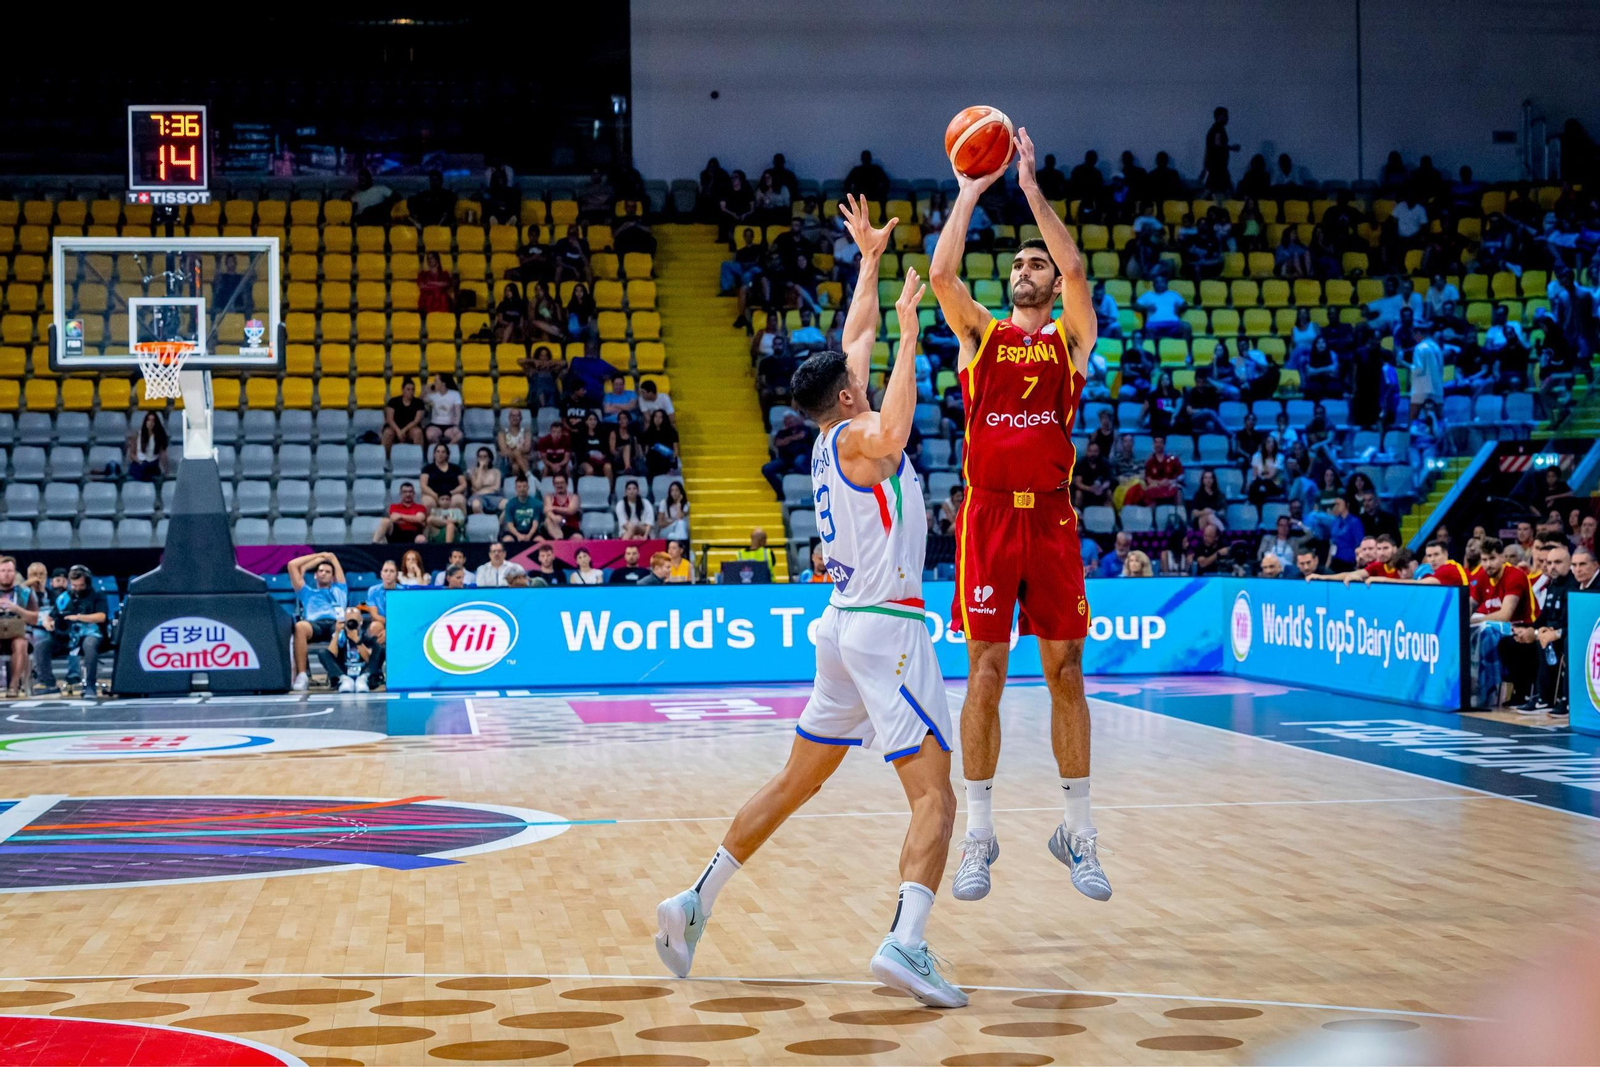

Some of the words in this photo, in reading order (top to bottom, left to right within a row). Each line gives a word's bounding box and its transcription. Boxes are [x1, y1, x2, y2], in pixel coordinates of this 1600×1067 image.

[150, 114, 200, 137] 7:36
[159, 144, 196, 181] 14
[150, 191, 210, 204] TISSOT
[996, 341, 1059, 364] ESPAÑA
[1021, 376, 1039, 399] 7
[160, 626, 225, 644] 百岁山
[446, 624, 497, 652] Yili
[560, 607, 756, 652] World's
[1089, 615, 1167, 649] oup
[1262, 603, 1313, 650] World's
[1315, 606, 1355, 665] Top5
[1357, 616, 1392, 669] Dairy
[1394, 619, 1440, 675] Group
